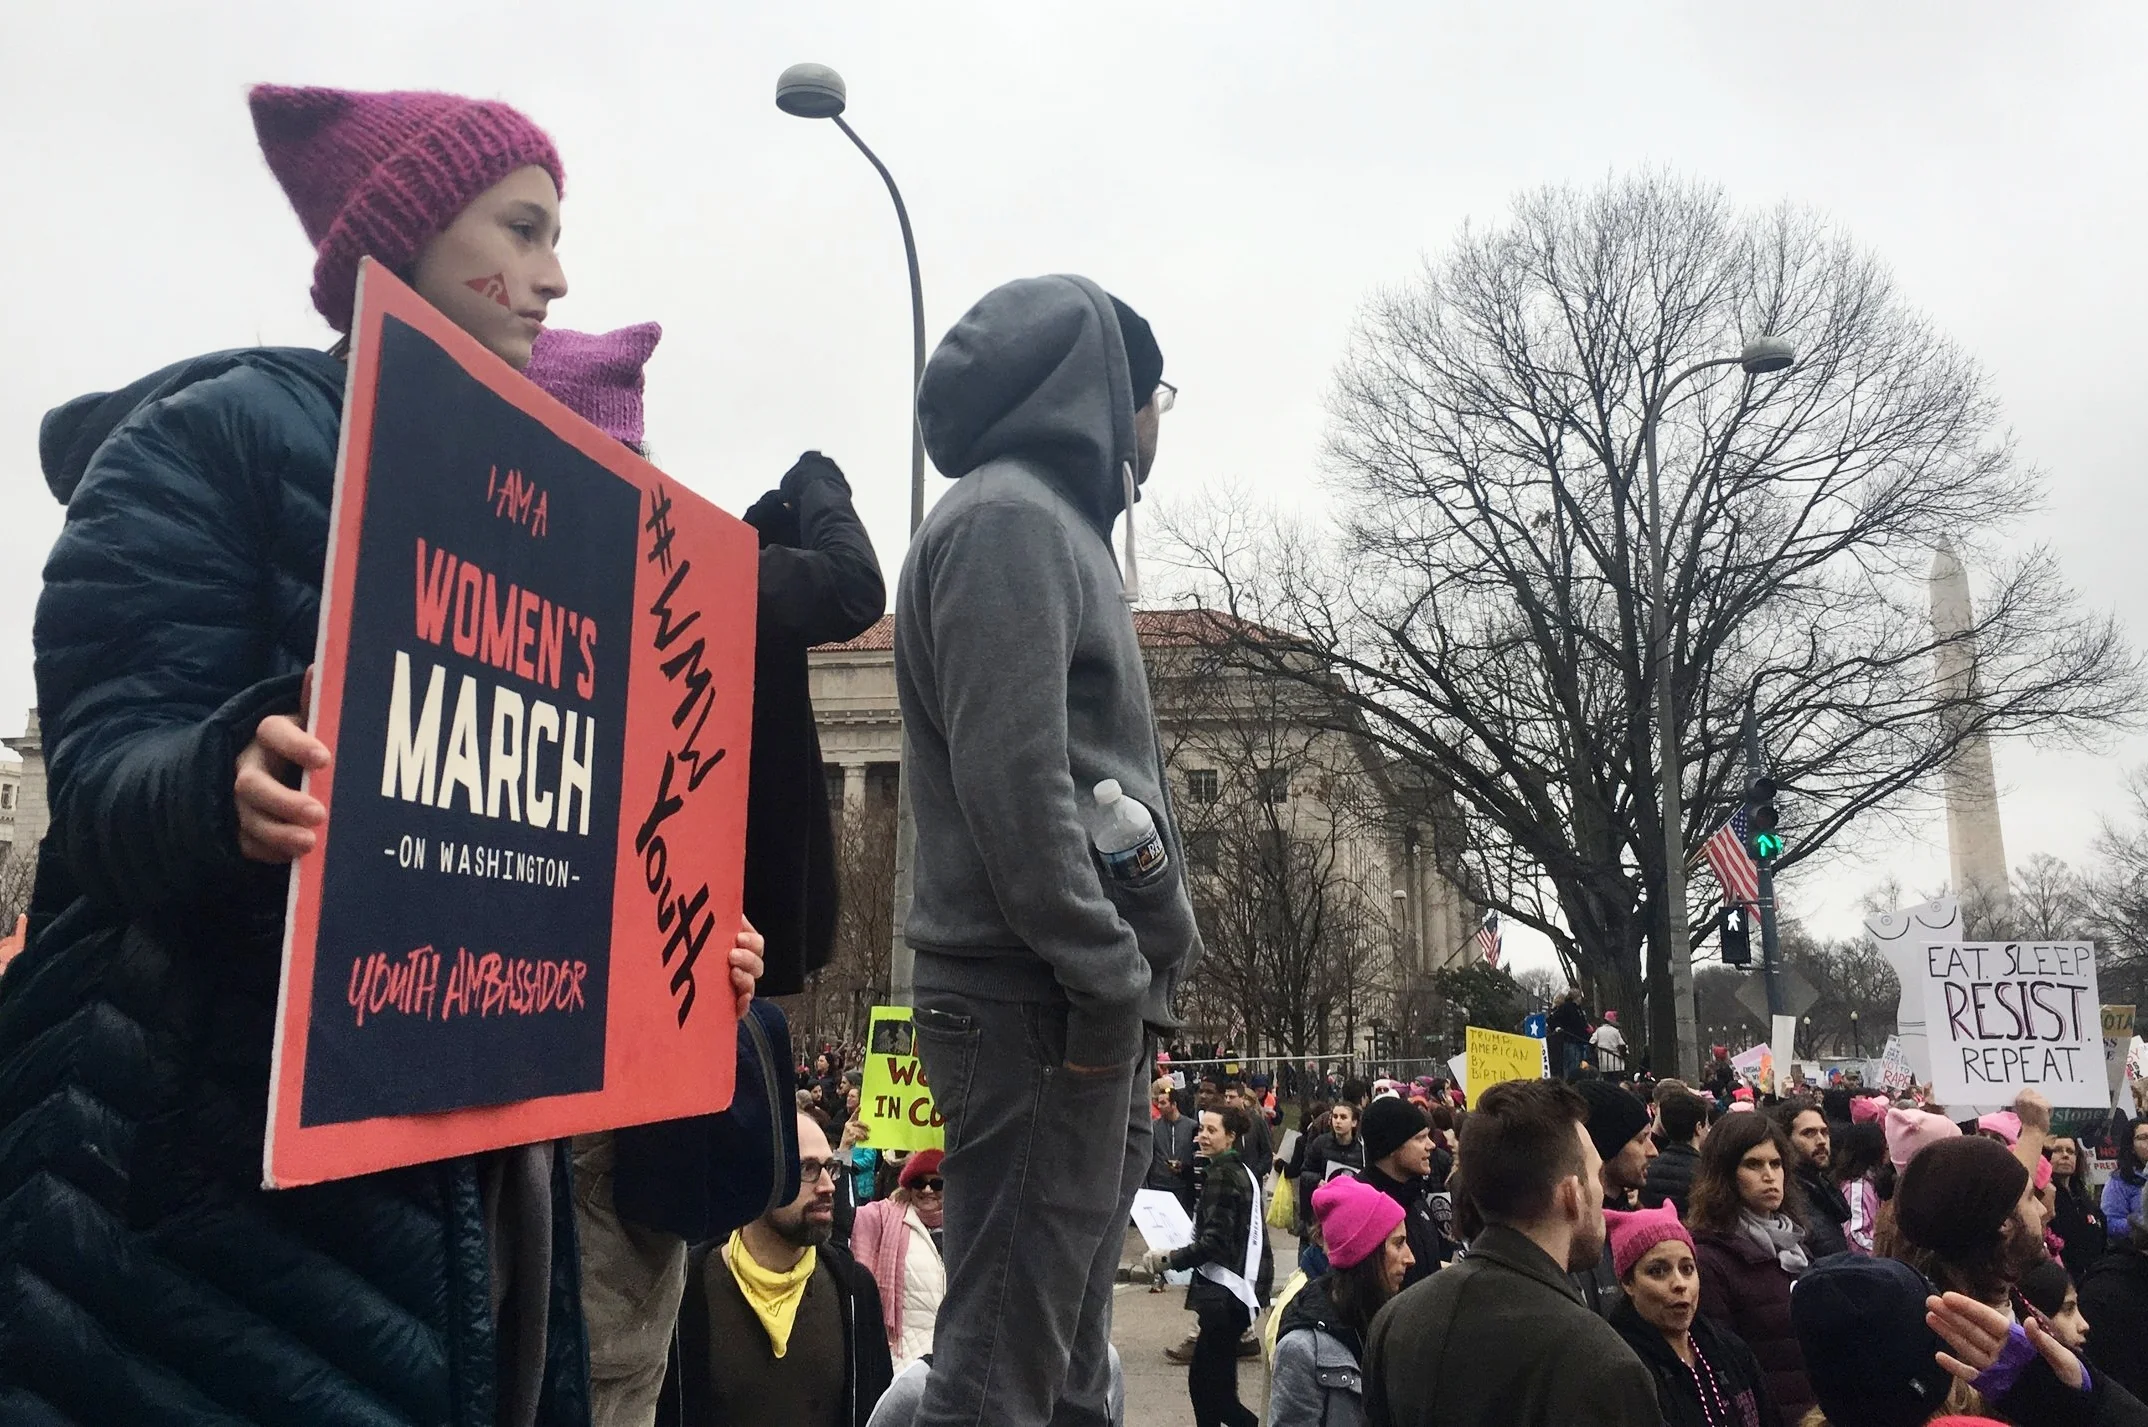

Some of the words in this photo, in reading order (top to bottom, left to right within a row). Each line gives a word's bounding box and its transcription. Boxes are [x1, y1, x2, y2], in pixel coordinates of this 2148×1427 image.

[487, 464, 497, 502] I
[496, 468, 535, 525] AM
[532, 490, 548, 537] A
[415, 536, 598, 701] WOMEN'S
[381, 649, 595, 836] MARCH
[441, 946, 588, 1022] AMBASSADOR
[1928, 946, 1989, 980] EAT.
[2002, 943, 2090, 977] SLEEP.
[1944, 980, 2091, 1043] RESIST.
[1471, 1042, 1529, 1061] AMERICAN
[1471, 1055, 1486, 1069] BY
[1962, 1045, 2084, 1084] REPEAT.
[874, 1095, 901, 1120] IN
